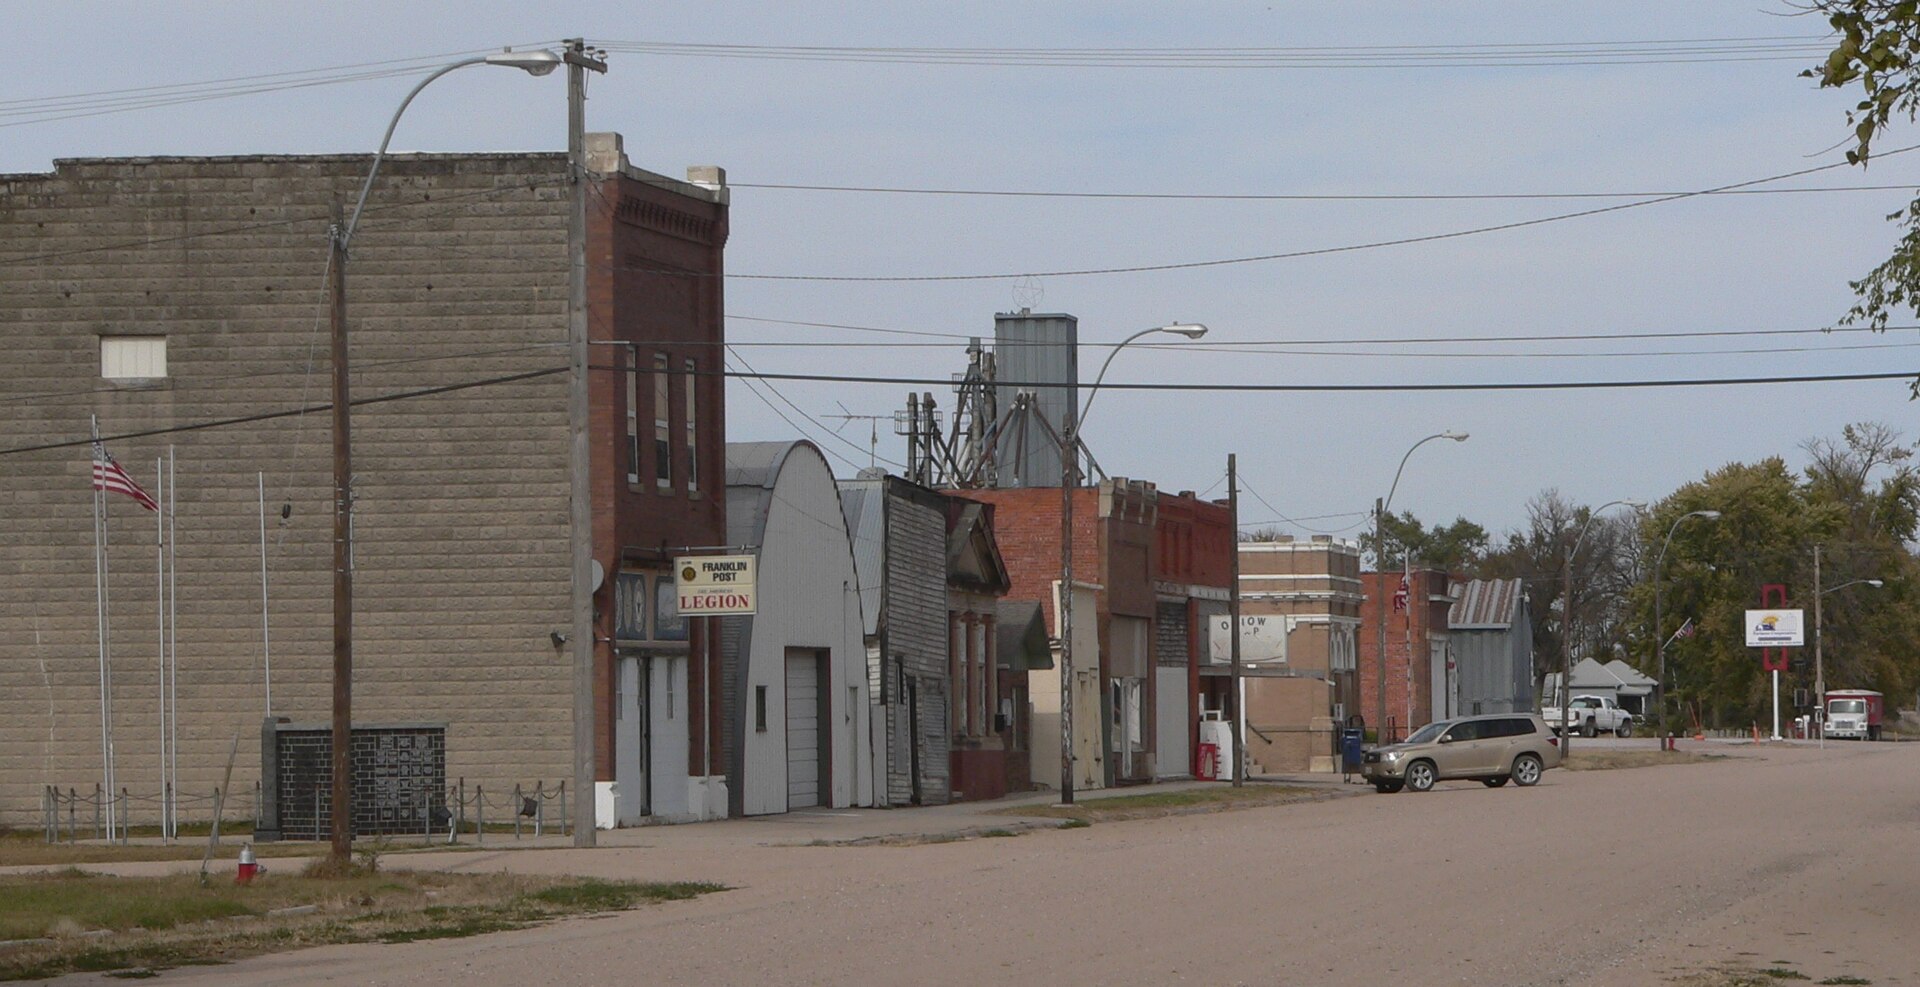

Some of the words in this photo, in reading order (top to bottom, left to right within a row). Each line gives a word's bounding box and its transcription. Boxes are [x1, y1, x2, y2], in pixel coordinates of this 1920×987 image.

[702, 561, 747, 572] FRANKLIN
[712, 572, 737, 582] POST
[681, 595, 749, 609] LEGION
